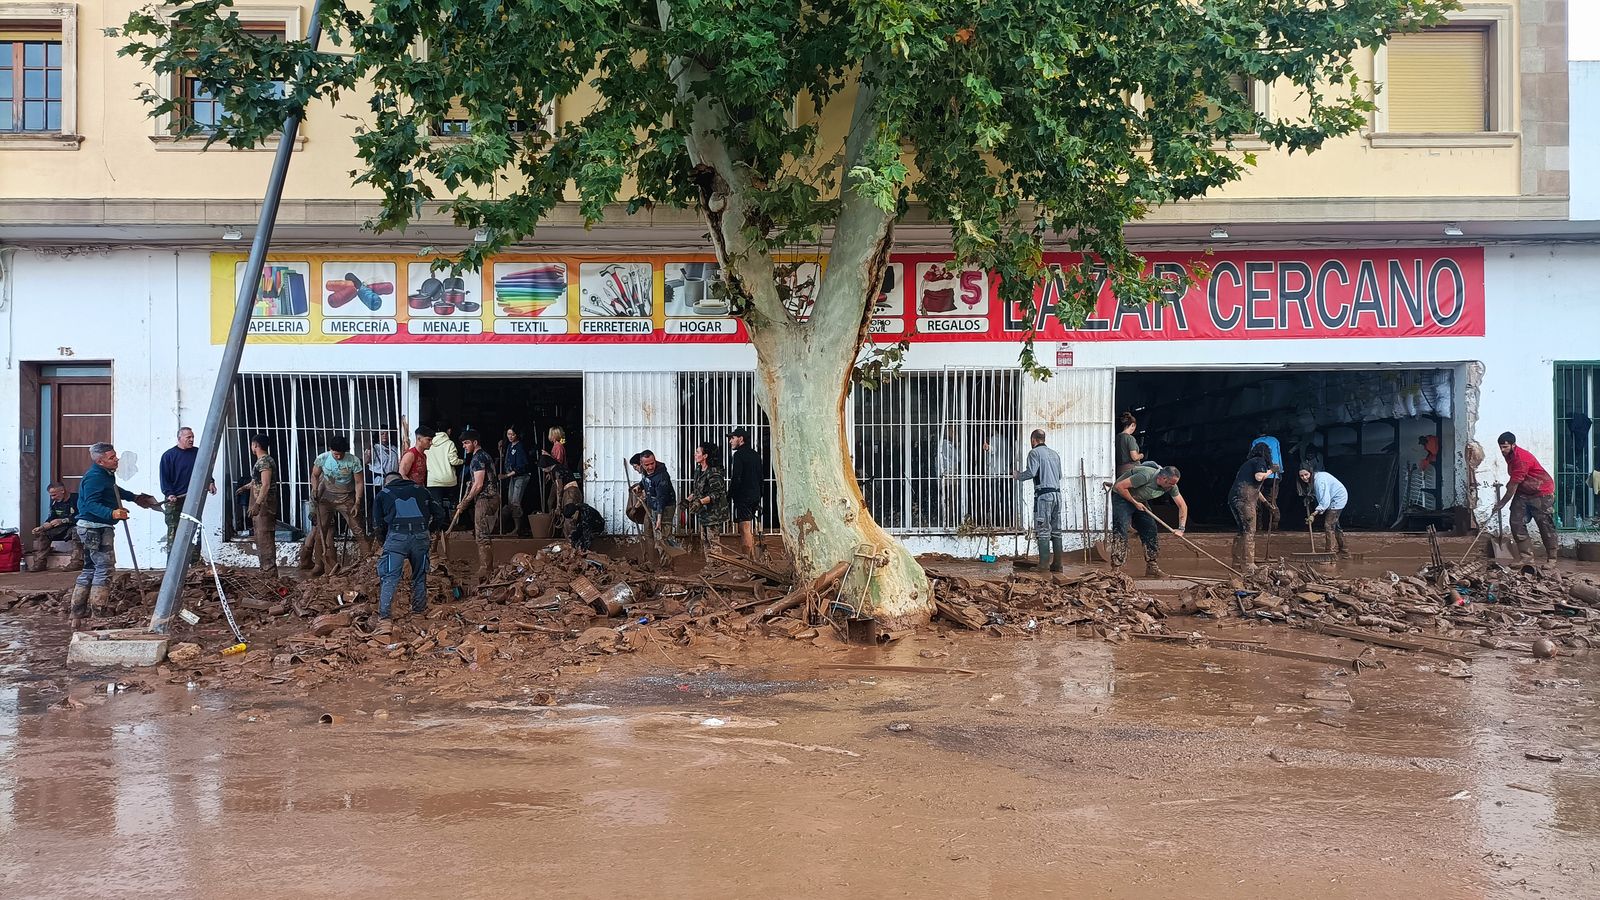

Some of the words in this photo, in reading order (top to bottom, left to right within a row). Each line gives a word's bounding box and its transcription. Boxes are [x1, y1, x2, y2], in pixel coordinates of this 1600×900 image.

[1207, 257, 1466, 331] CERCANO
[248, 321, 304, 332] APELERIA
[330, 319, 390, 332] MERCERÍA
[423, 321, 470, 332] MENAJE
[510, 321, 549, 332] TEXTIL
[583, 321, 650, 332] FERRETERIA
[679, 321, 722, 332] HOGAR
[927, 319, 980, 331] REGALOS
[57, 346, 74, 356] 15
